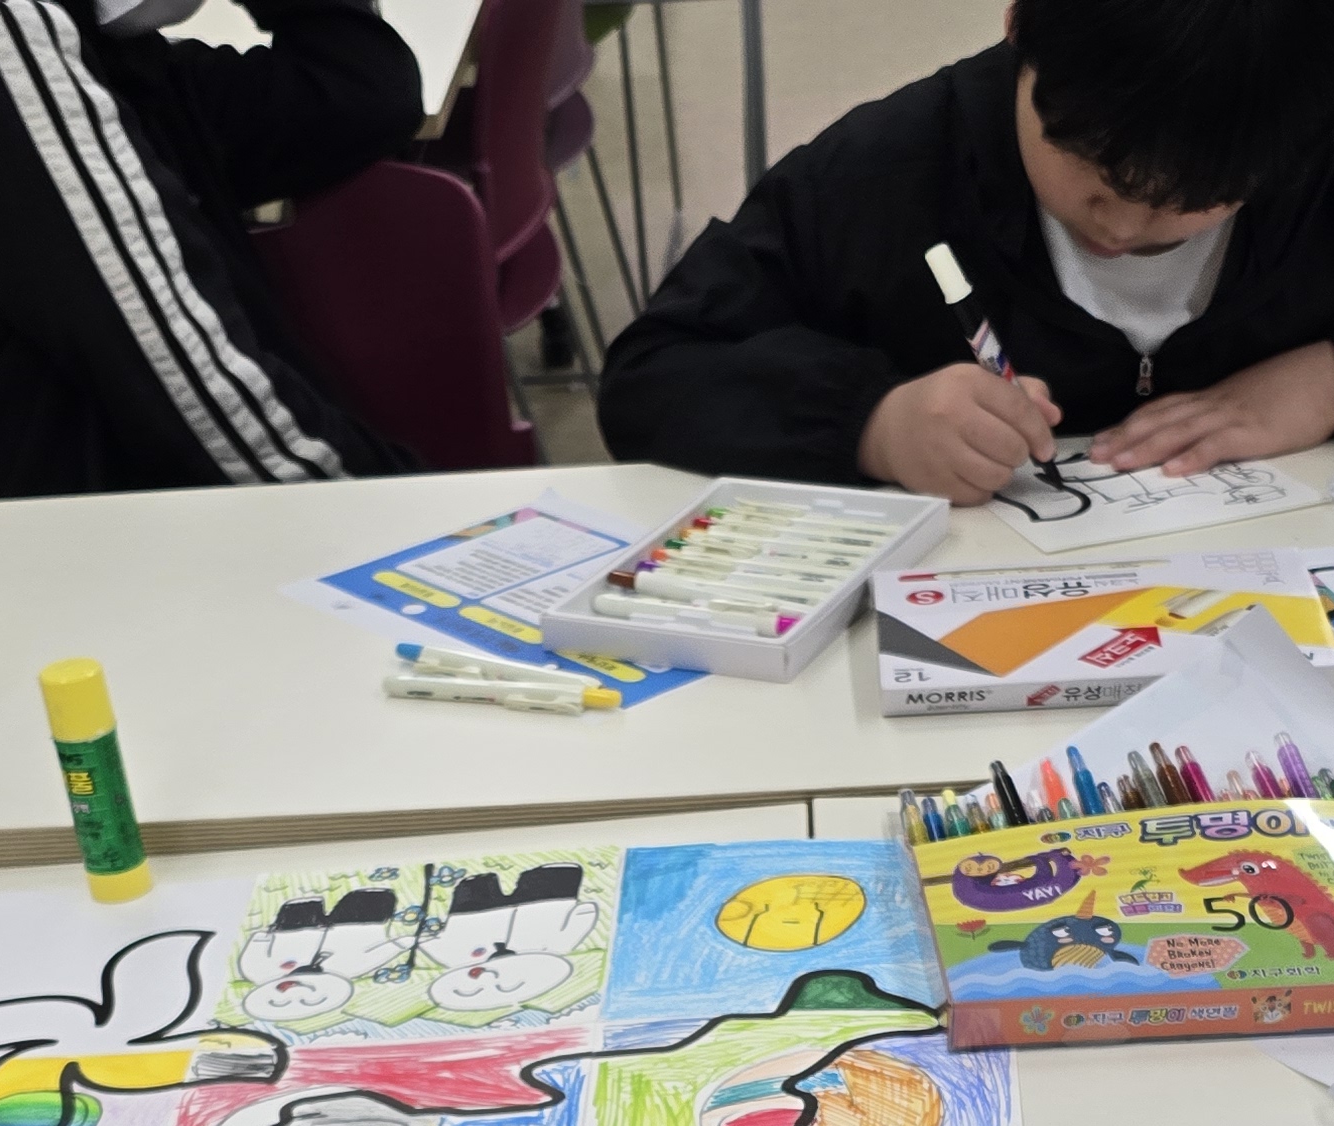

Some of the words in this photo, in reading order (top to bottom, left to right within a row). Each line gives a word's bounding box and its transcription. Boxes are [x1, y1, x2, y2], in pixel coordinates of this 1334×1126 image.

[950, 581, 1091, 603] 유성매직
[906, 690, 986, 705] MORRIS
[1139, 807, 1310, 845] 투명이
[1022, 885, 1062, 900] YAY!
[1203, 895, 1294, 932] 50
